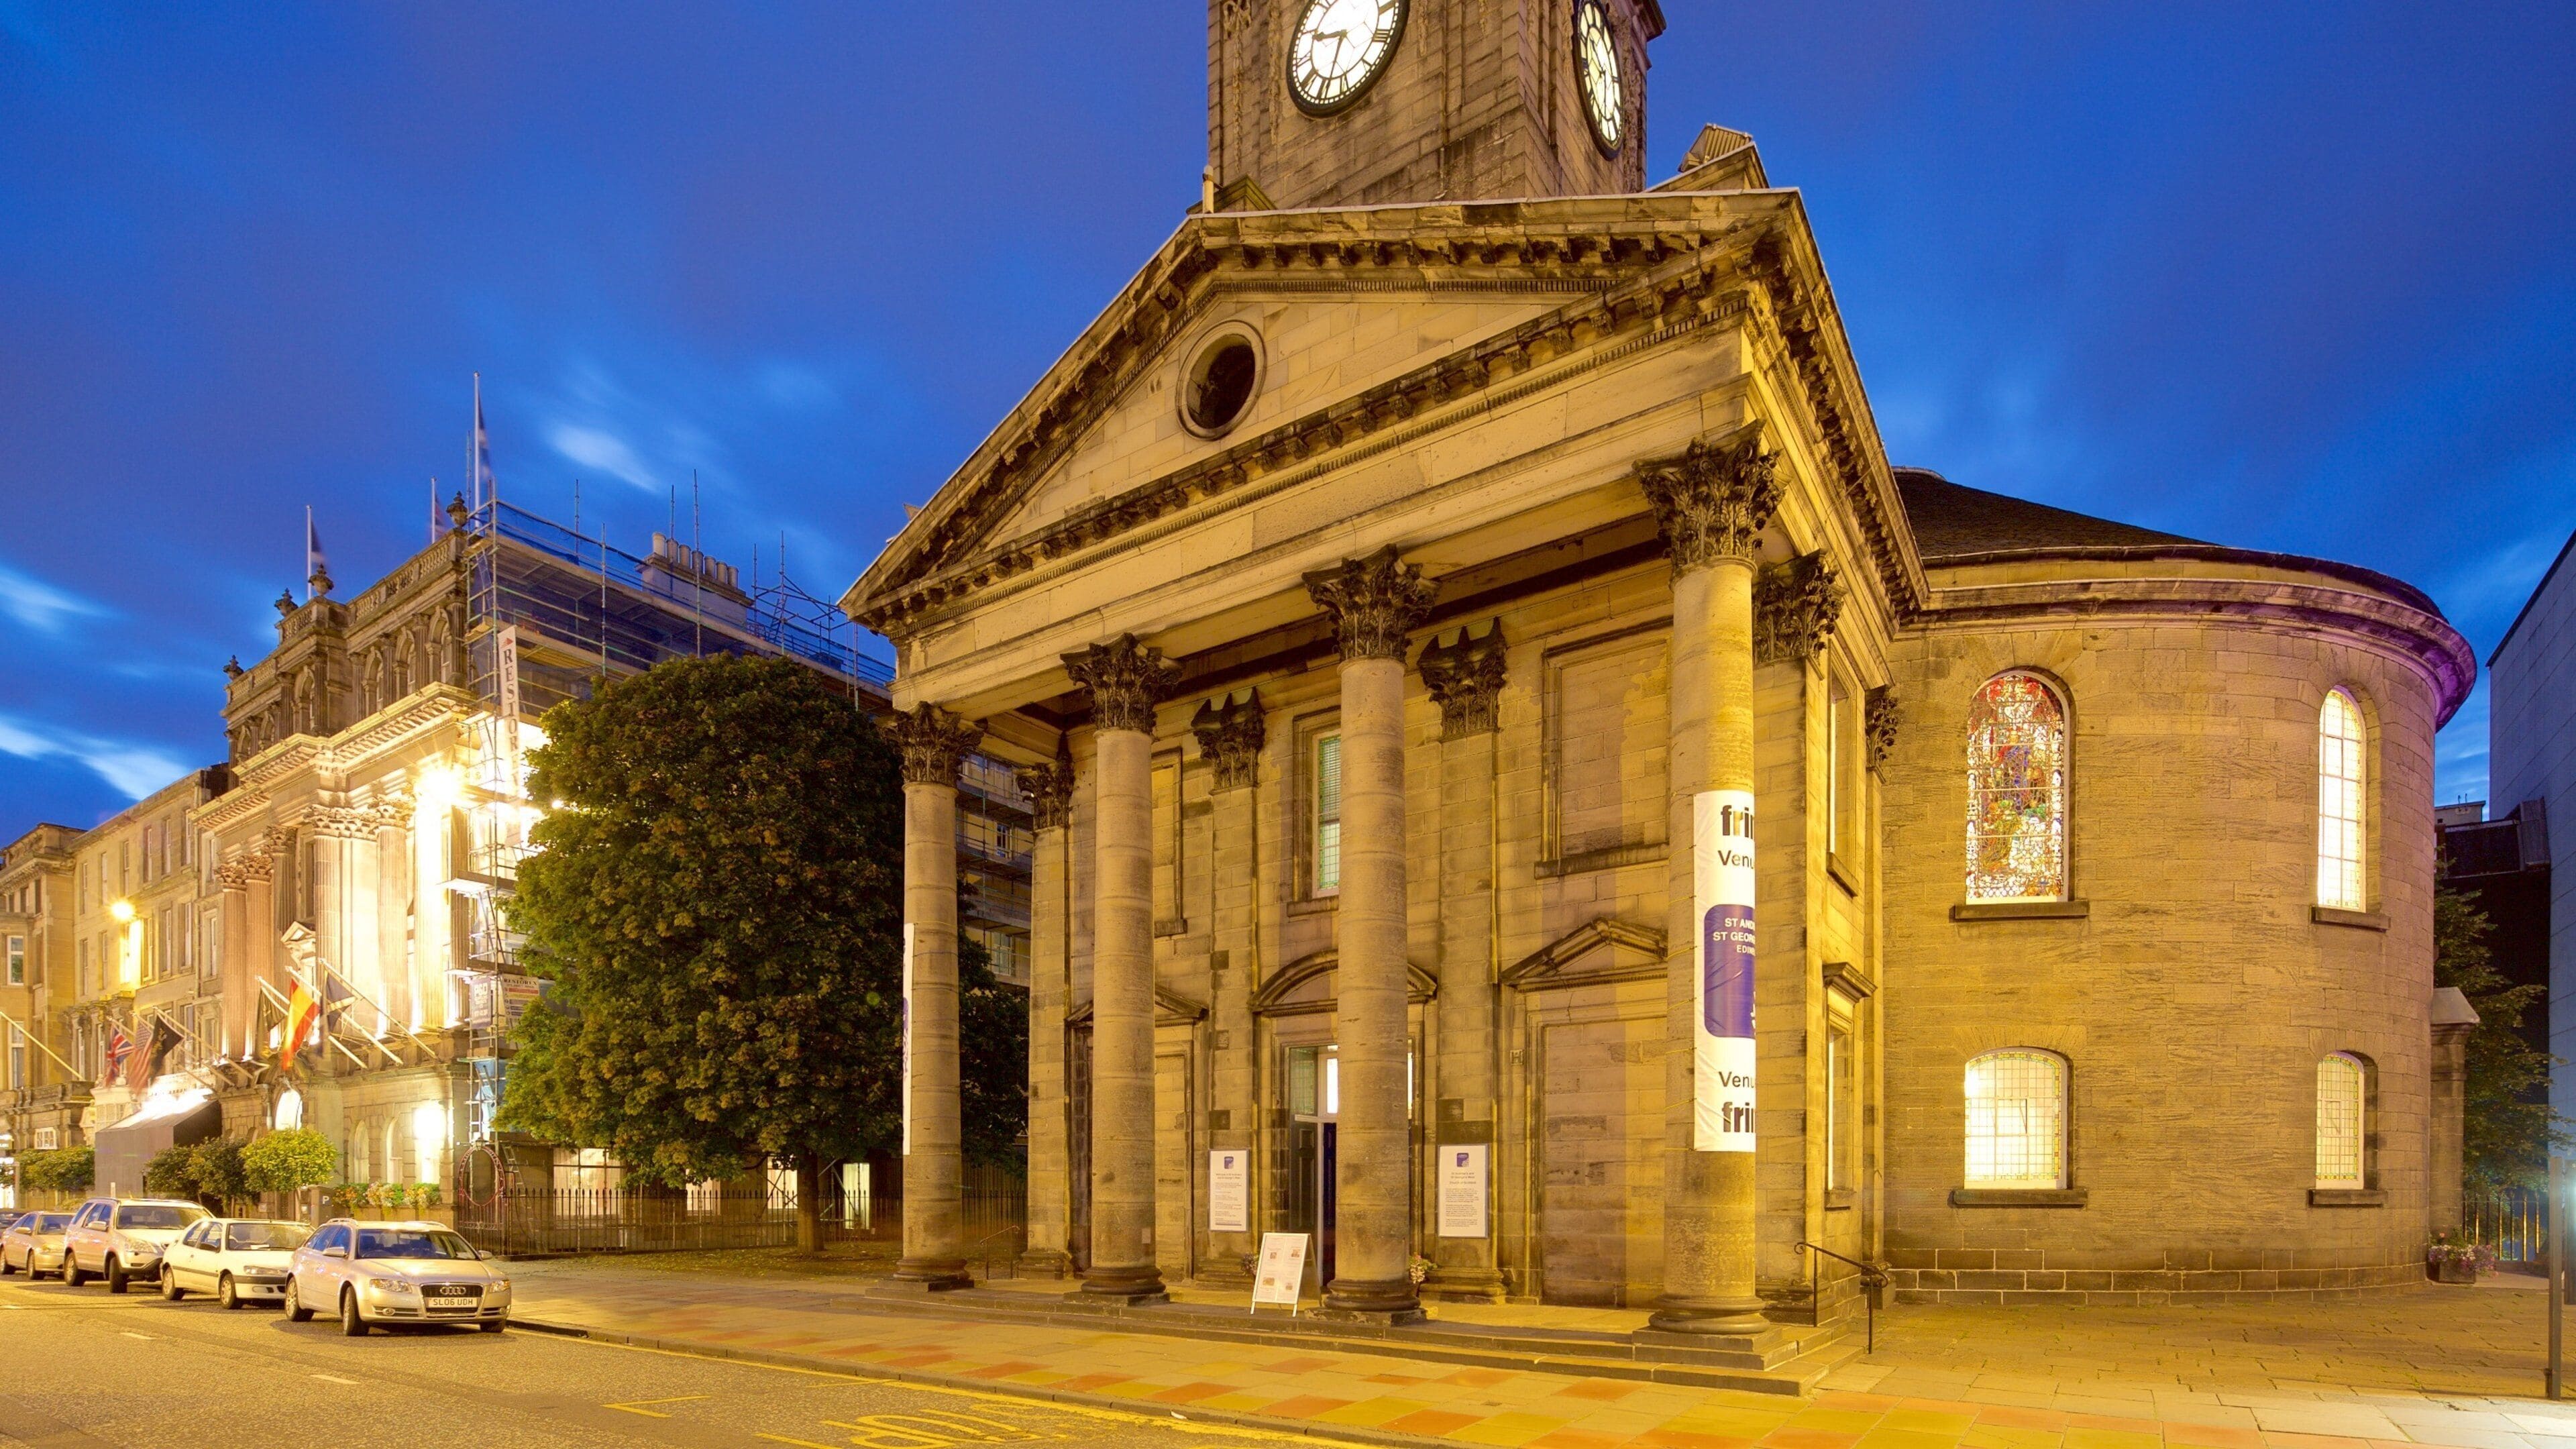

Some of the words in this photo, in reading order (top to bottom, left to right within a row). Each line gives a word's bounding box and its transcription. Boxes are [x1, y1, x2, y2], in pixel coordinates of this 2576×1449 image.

[1725, 917, 1738, 928] ST
[1713, 931, 1728, 942] ST
[322, 1195, 330, 1204] P
